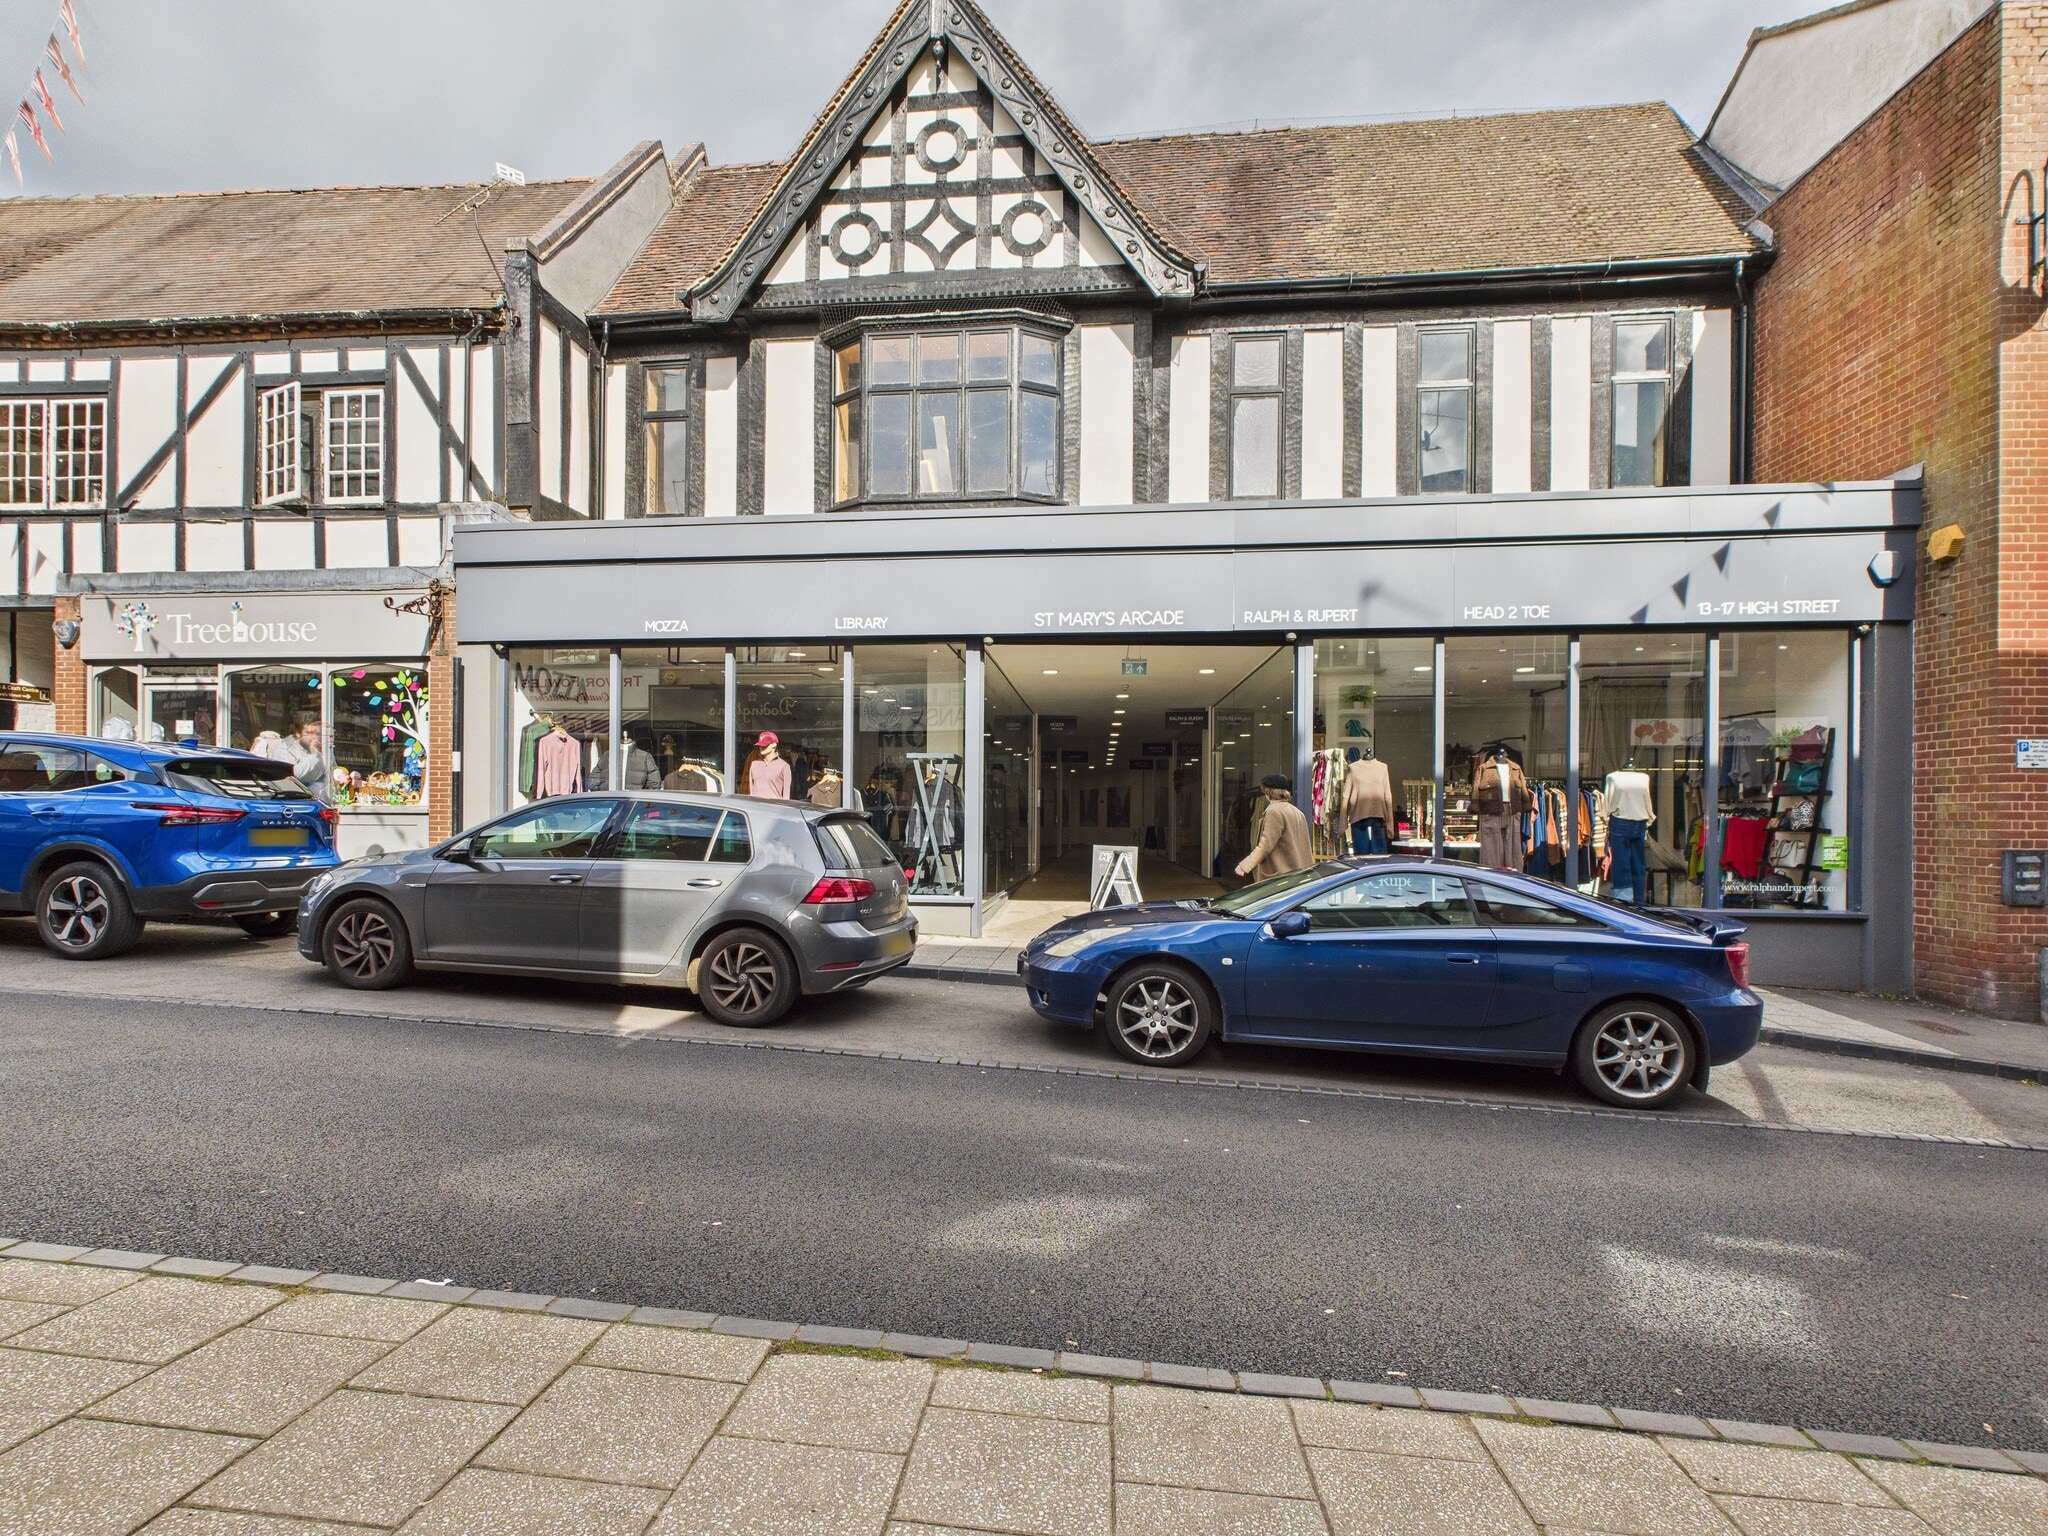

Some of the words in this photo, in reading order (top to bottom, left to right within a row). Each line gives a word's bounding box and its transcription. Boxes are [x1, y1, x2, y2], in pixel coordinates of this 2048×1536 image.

[1464, 606, 1505, 619] HEAD
[1508, 606, 1518, 619] 2
[1521, 605, 1550, 618] TOE
[1739, 601, 1778, 614] HIGH
[1782, 600, 1840, 614] STREET
[1034, 612, 1054, 627] ST
[1059, 611, 1115, 626] MARY'S
[1119, 610, 1184, 625] ARCADE
[1244, 610, 1290, 623] RALPH
[1293, 610, 1304, 622] &
[1307, 609, 1359, 622] RUPERT
[166, 611, 318, 644] Treehouse
[645, 620, 689, 632] MOZZA
[835, 617, 888, 630] LIBRARY
[2021, 743, 2028, 751] P
[1724, 882, 1837, 894] www.ralphandrupert.com
